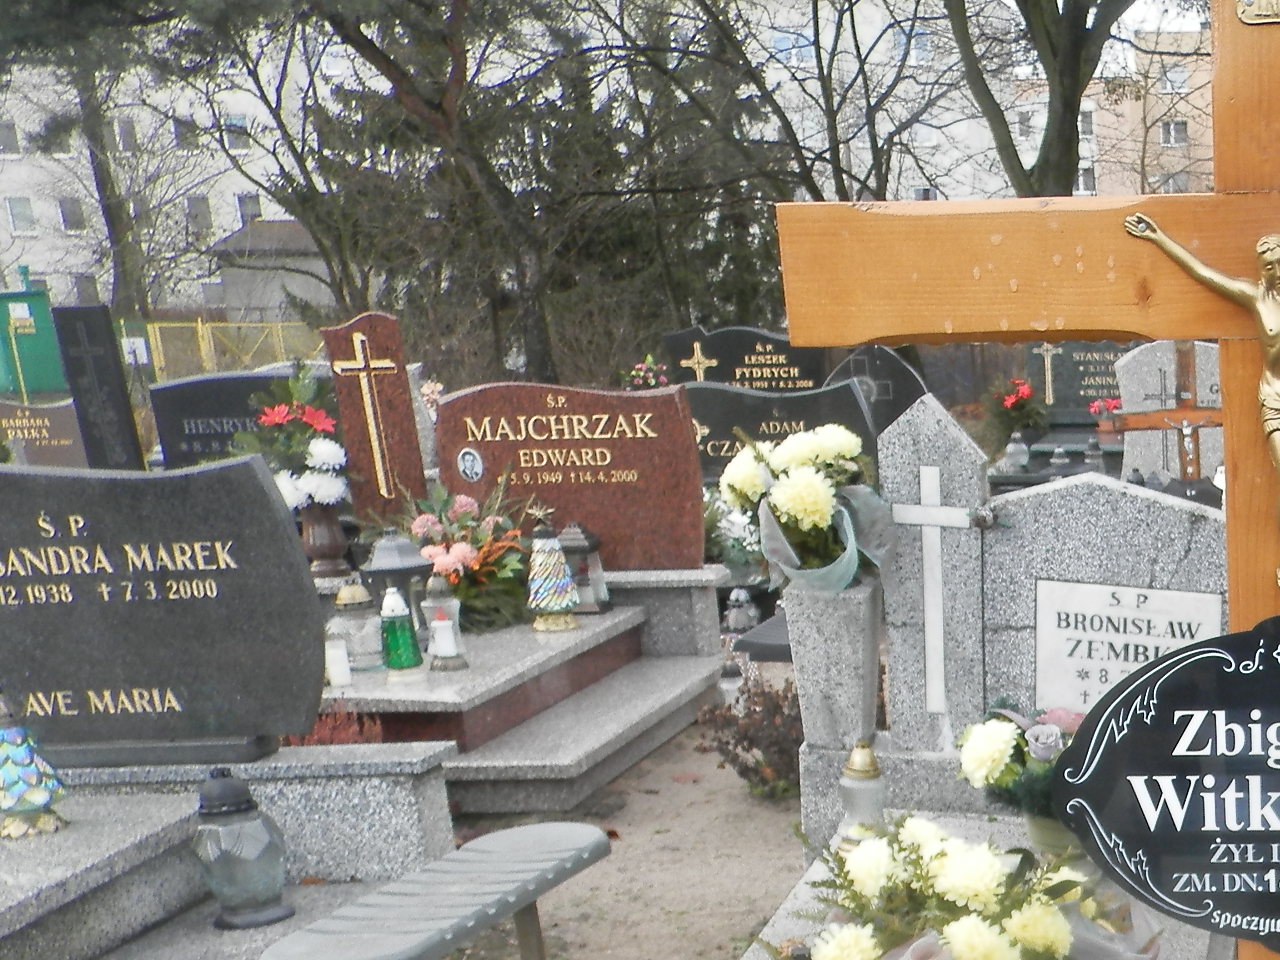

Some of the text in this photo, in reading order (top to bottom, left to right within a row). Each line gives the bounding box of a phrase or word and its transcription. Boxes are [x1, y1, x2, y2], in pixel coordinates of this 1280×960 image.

[744, 354, 788, 365] LESZEK
[735, 367, 800, 380] FYDRYCH
[2, 417, 51, 428] BARBARA
[183, 417, 259, 434] HENRYK
[463, 413, 659, 442] MAJCHRZAK
[758, 421, 806, 434] ADAM
[518, 448, 612, 468] EDWARD
[536, 471, 563, 485] 1949
[611, 470, 638, 483] 2000
[123, 540, 239, 573] MAREK
[26, 583, 74, 604] 1938
[166, 578, 219, 600] 2000
[1056, 611, 1202, 641] BRONISŁAW
[26, 687, 182, 717] AVE MARIA
[1209, 838, 1264, 863] ŻYŁ
[1172, 873, 1218, 893] ZM.
[1222, 873, 1263, 893] DN.
